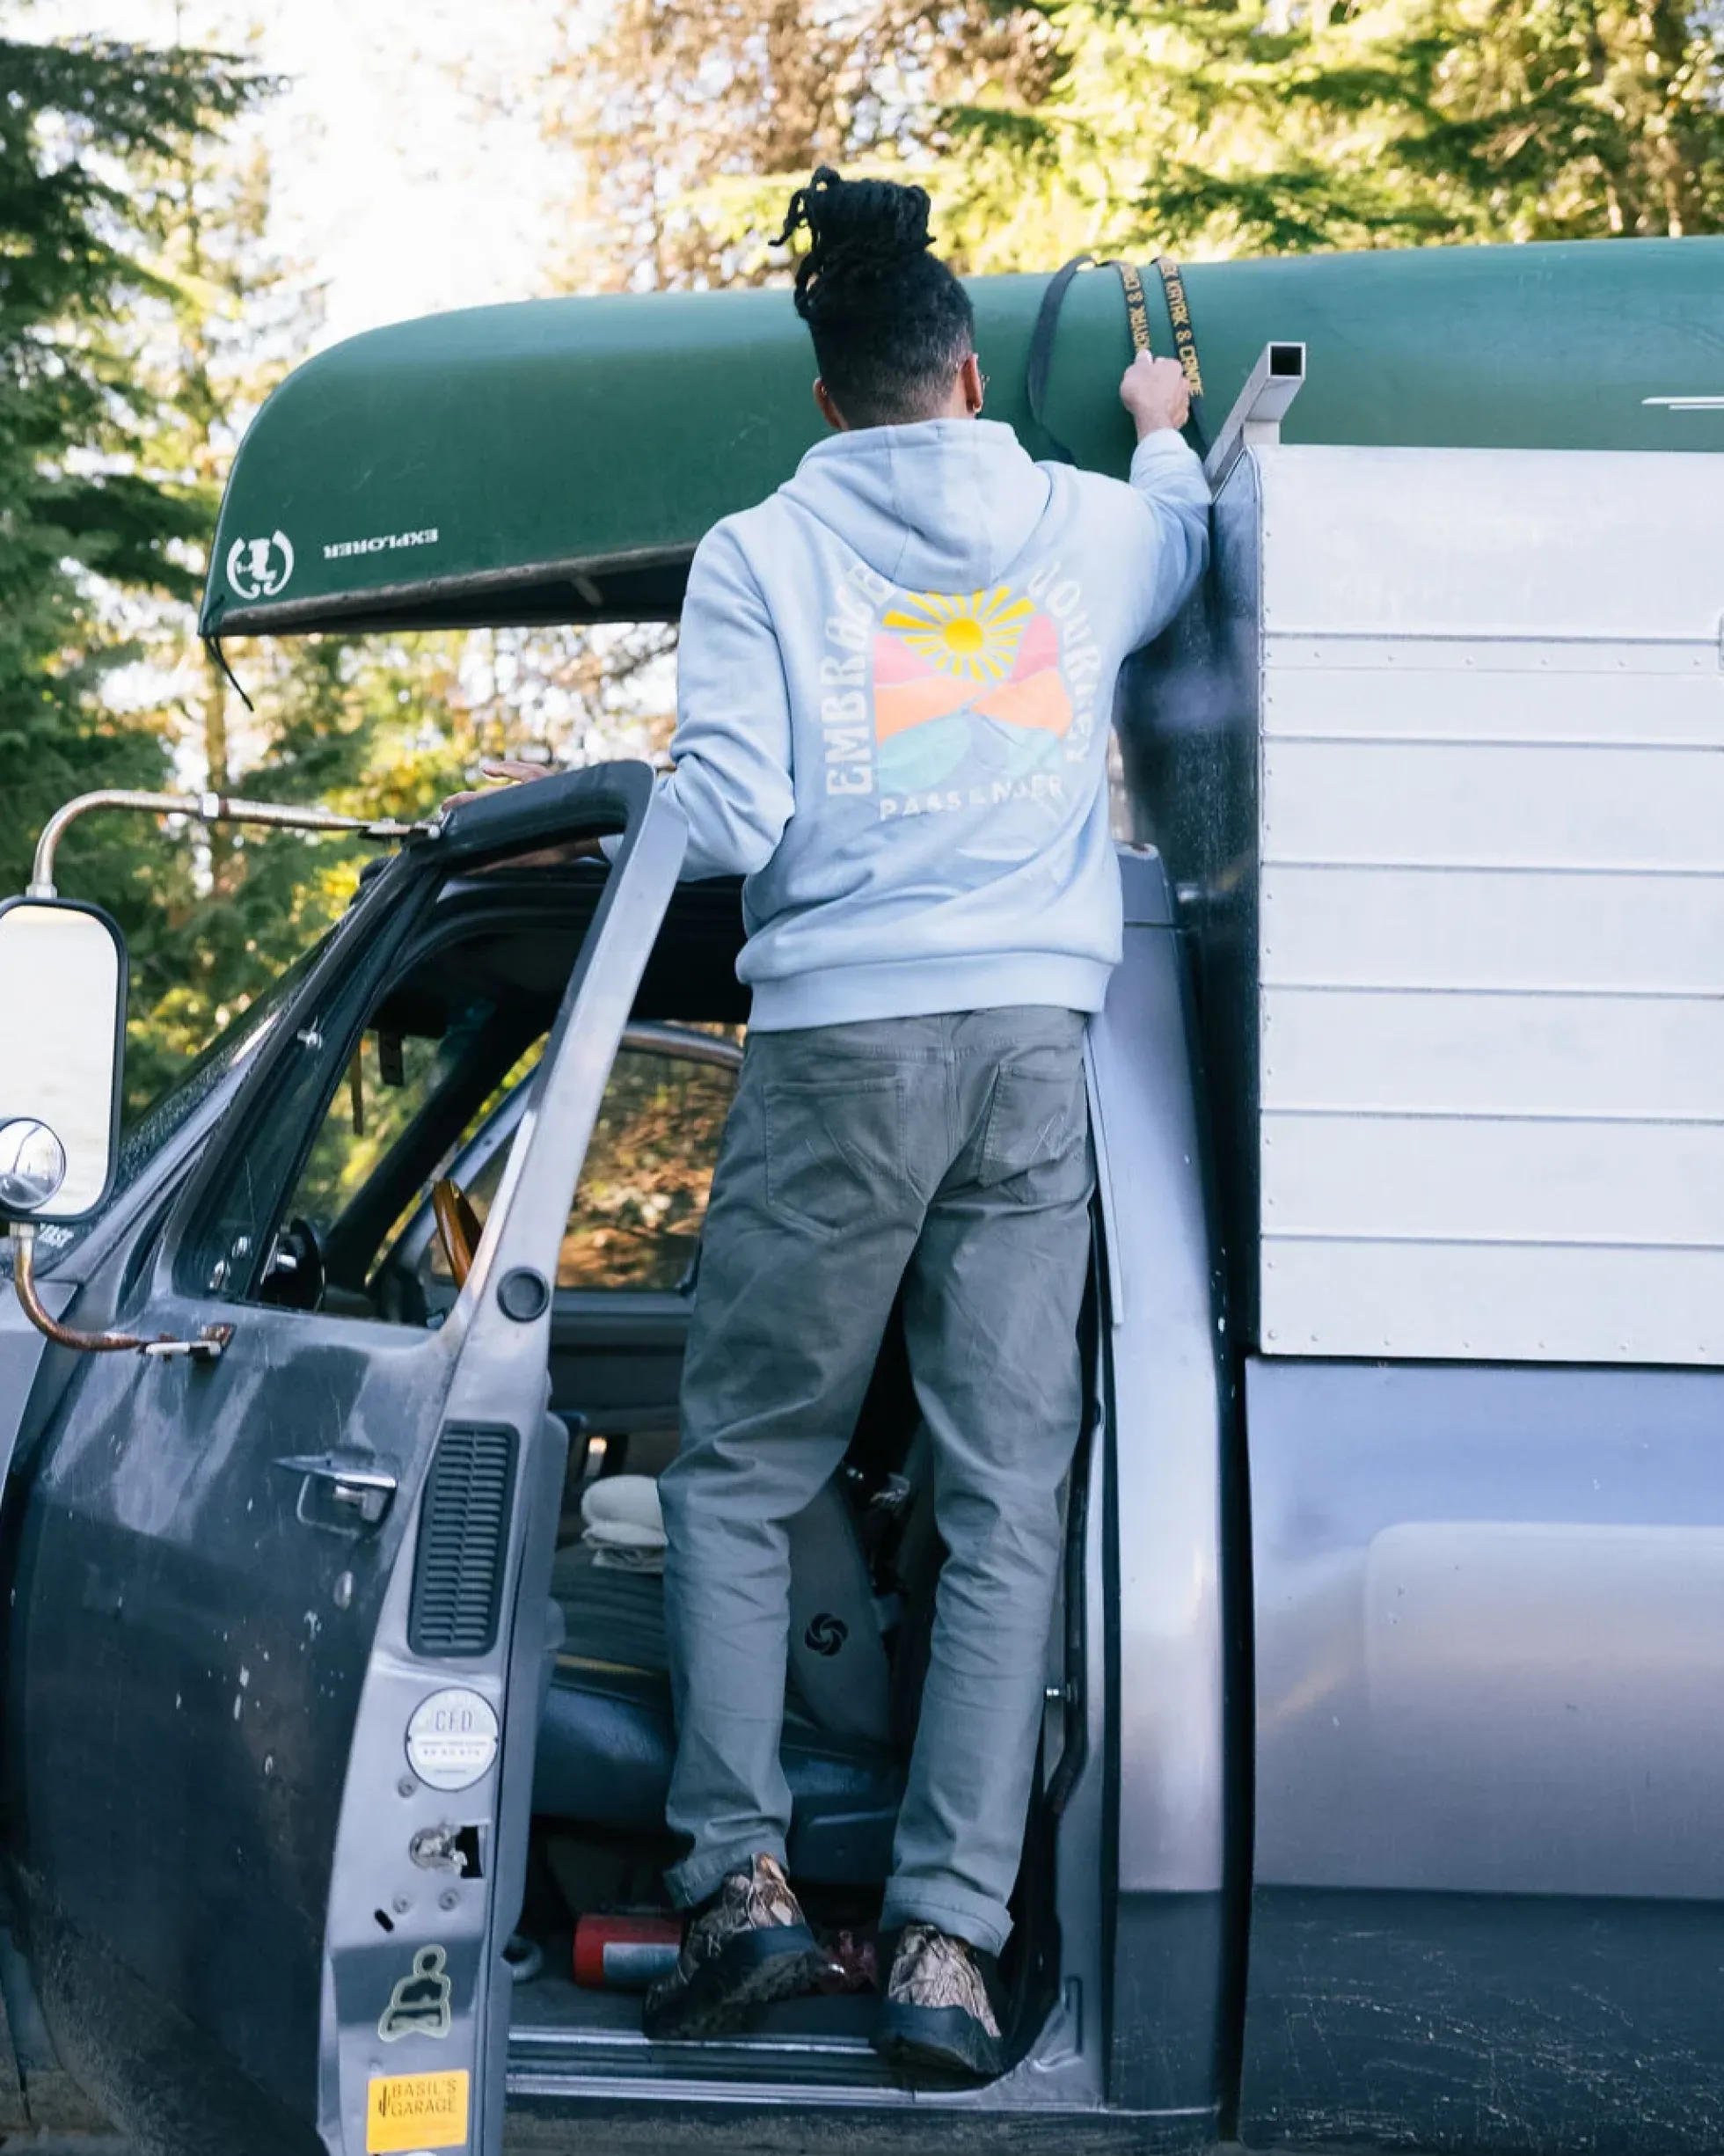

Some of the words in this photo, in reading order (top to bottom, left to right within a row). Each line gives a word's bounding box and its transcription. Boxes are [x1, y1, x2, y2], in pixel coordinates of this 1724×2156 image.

[1176, 330, 1193, 344] &
[324, 528, 439, 559] EXPLORER
[392, 2079, 457, 2099] BASIL'S
[391, 2096, 457, 2117] GARAGE
